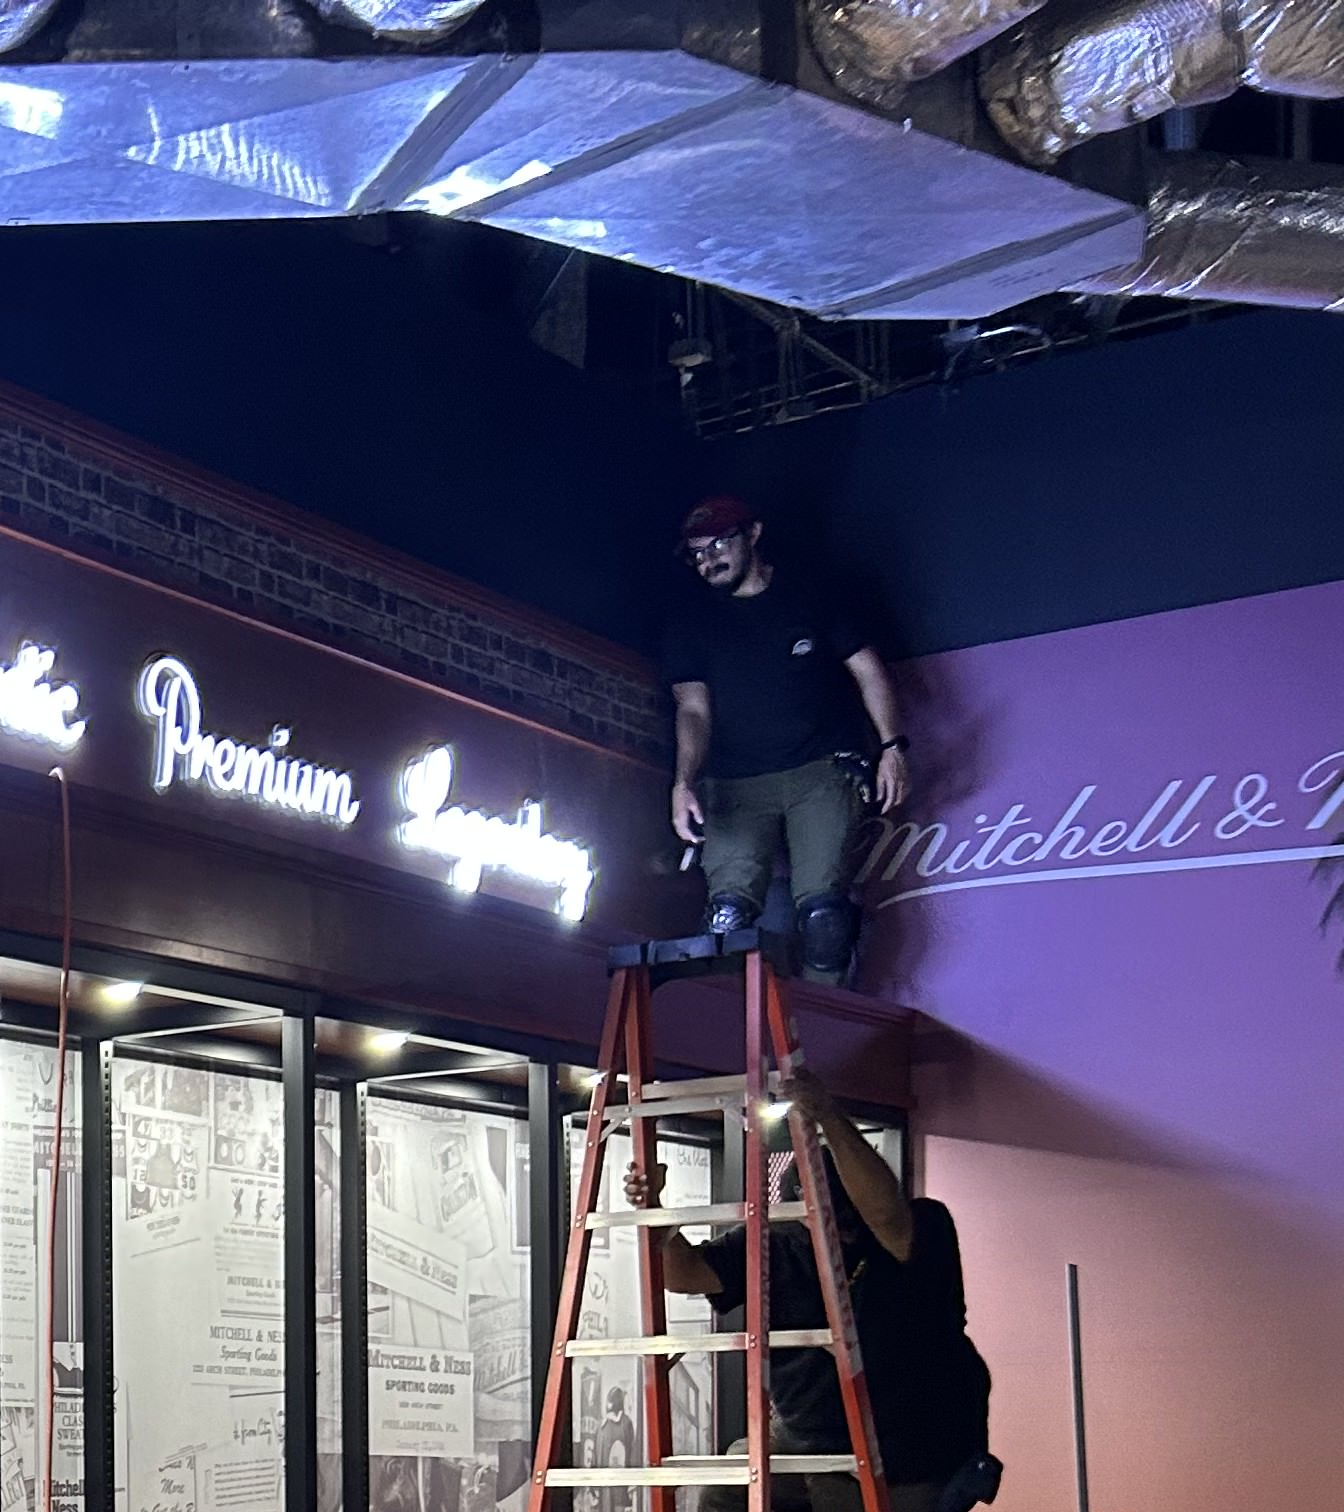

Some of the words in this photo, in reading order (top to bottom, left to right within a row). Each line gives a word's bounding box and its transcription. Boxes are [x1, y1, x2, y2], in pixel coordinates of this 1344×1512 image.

[136, 652, 362, 830] Premium
[850, 774, 1201, 885] Mitchell
[1213, 772, 1286, 841] &
